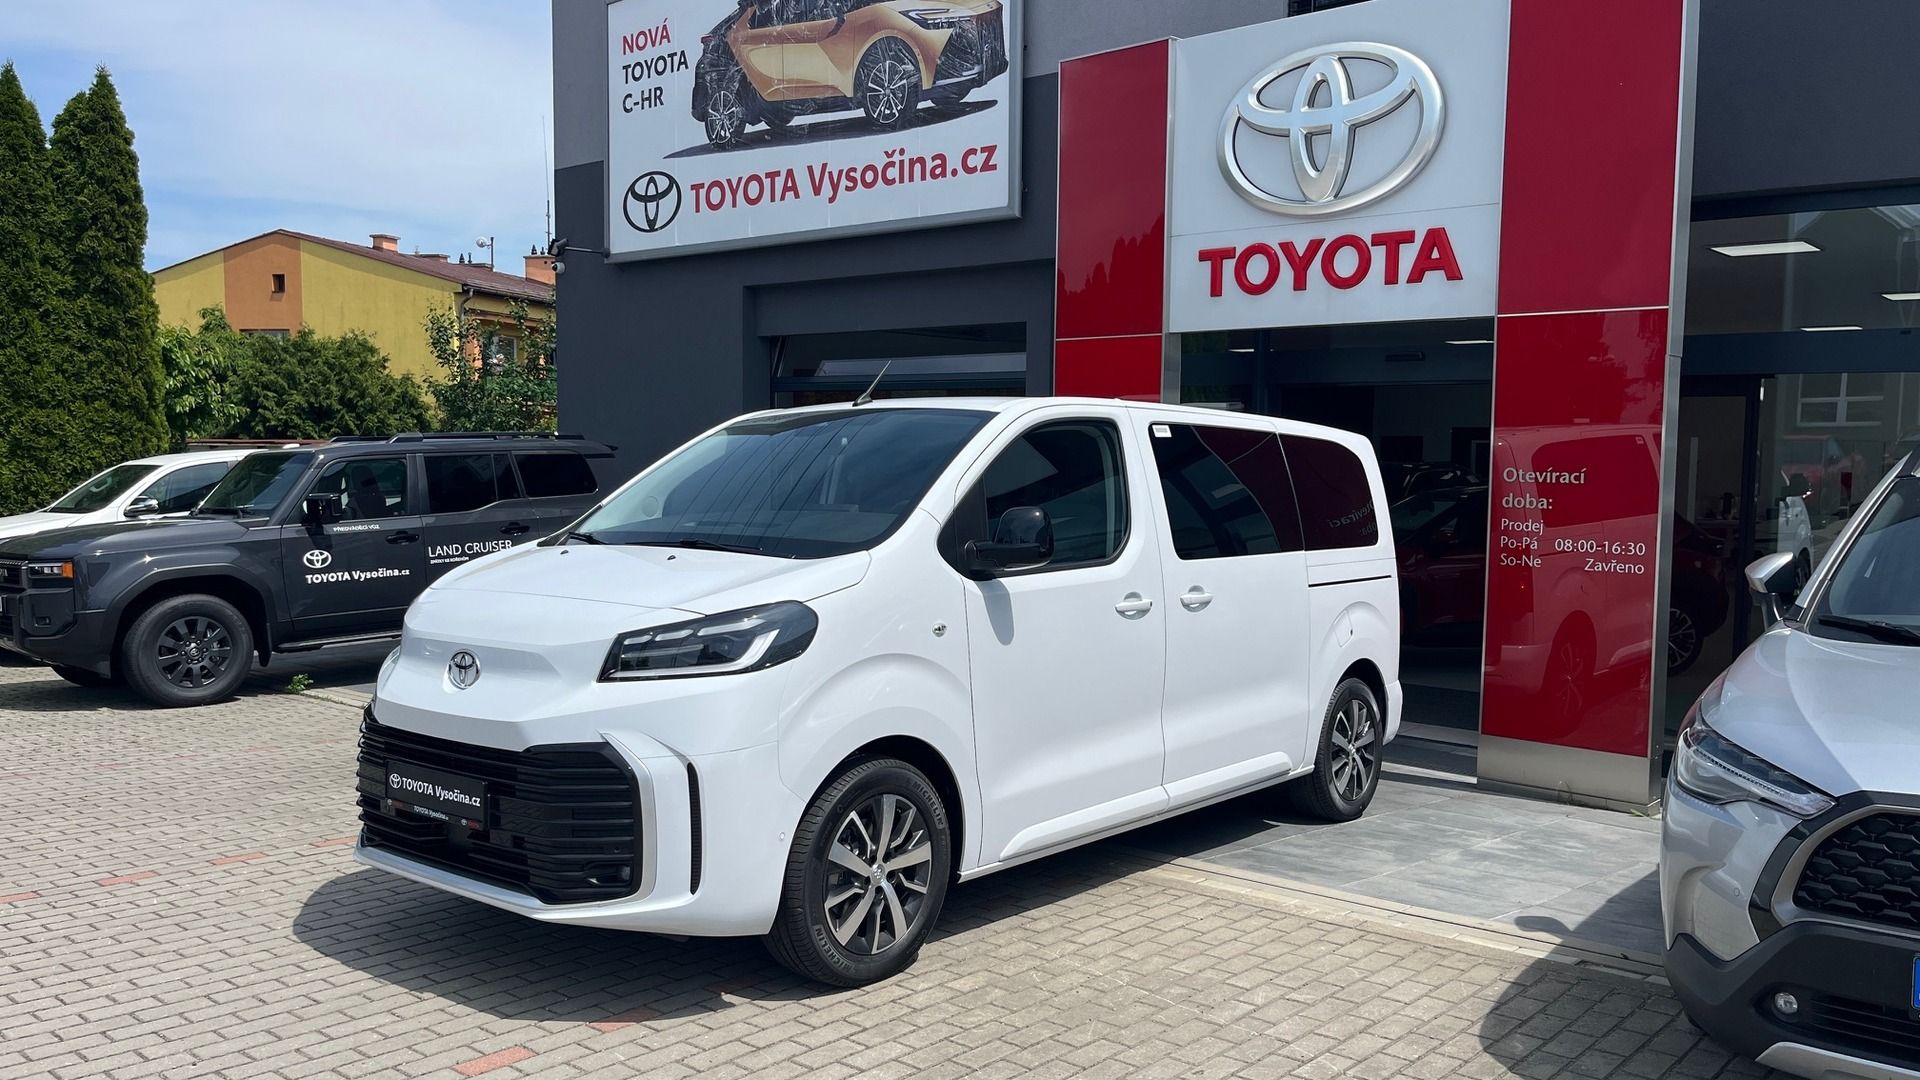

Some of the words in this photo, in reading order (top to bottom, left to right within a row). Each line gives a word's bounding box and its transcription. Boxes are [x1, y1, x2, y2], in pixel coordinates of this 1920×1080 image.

[622, 17, 671, 55] NOVÁ
[622, 50, 689, 84] TOYOTA
[622, 86, 664, 114] C-HR
[690, 169, 800, 214] TOYOTA
[806, 143, 998, 204] Vysočina.cz
[1199, 227, 1463, 297] TOYOTA
[1503, 467, 1587, 484] Otevírací
[1502, 493, 1553, 509] doba:
[1501, 518, 1544, 535] Prodej
[428, 544, 461, 557] LAND
[464, 540, 512, 554] CRUISER
[1500, 536, 1538, 550] Po-Pá
[1555, 538, 1646, 556] 08:00-16:30
[305, 571, 351, 584] TOYOTA
[352, 567, 410, 582] Vysočina.cz
[1500, 554, 1542, 568] So-Ne
[1584, 558, 1645, 575] Zavřeno
[402, 777, 434, 796] TOYOTA
[435, 785, 481, 807] Vysočina.cz
[911, 780, 944, 826] MICHELIN
[814, 926, 855, 971] MICHELIN
